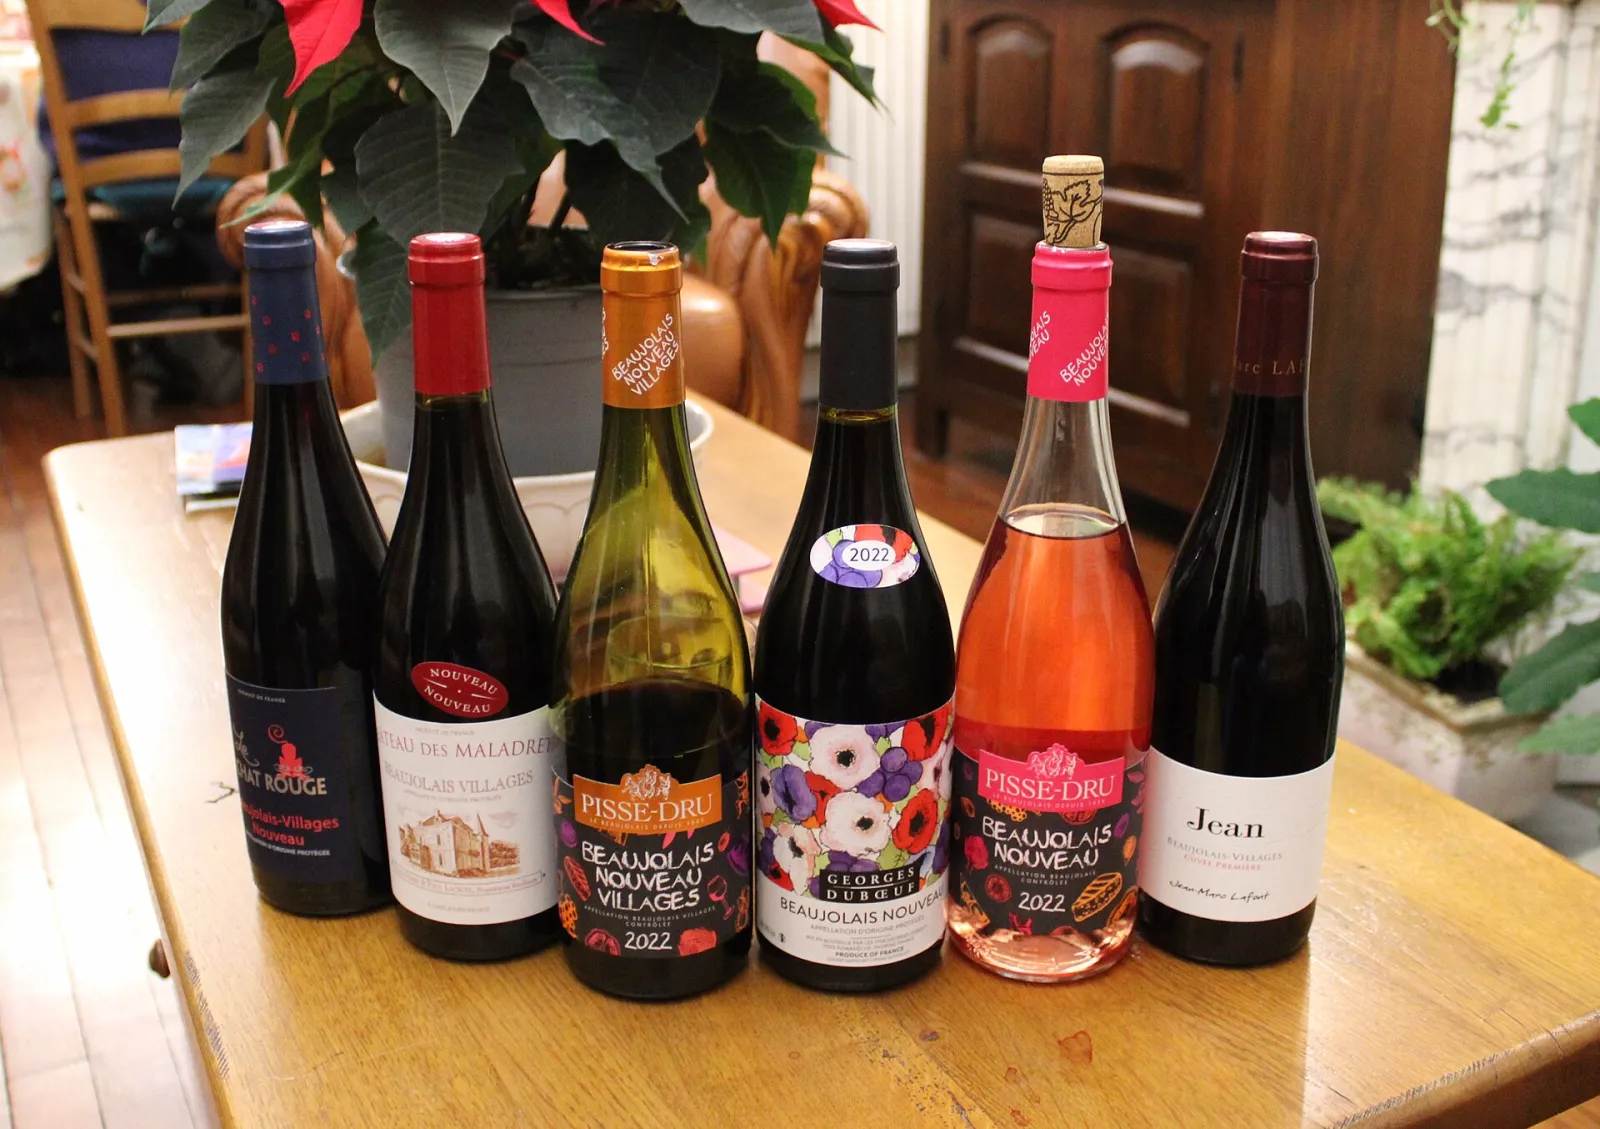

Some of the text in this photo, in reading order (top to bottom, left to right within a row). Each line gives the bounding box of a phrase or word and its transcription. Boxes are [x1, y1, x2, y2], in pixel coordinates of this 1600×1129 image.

[612, 313, 673, 380] BEAUJOLAIS
[623, 331, 674, 385] NOUVEAU
[631, 340, 679, 395] VILLAGES
[850, 547, 889, 561] 2022
[430, 667, 498, 695] NOUVEAU
[424, 685, 491, 714] NOUVEAU
[421, 742, 448, 757] DES
[264, 774, 327, 795] ROUGE
[384, 761, 534, 793] BEAUJOLAIS VILLAGES
[986, 768, 1116, 801] PISSE-DRU
[581, 793, 713, 822] PISSE-DRU
[252, 821, 305, 846] Nouveau
[982, 816, 1112, 849] BEAUJOLAIS
[1187, 806, 1265, 838] Jean
[582, 841, 714, 870] BEAUJOLAIS
[994, 842, 1099, 870] NOUVEAU
[596, 867, 702, 891] NOUVEAU
[828, 867, 914, 885] GEORGES
[995, 865, 1096, 879] APPELLATION BEAUJOLAIS
[584, 905, 629, 919] APPELLATION
[682, 905, 716, 918] VILLAGES
[598, 889, 700, 912] VILLAGES
[780, 884, 944, 924] BEAUJOLAIS NOUVEAU
[1018, 892, 1065, 912] 2022
[625, 931, 672, 950] 2022
[880, 946, 904, 955] FRANCE
